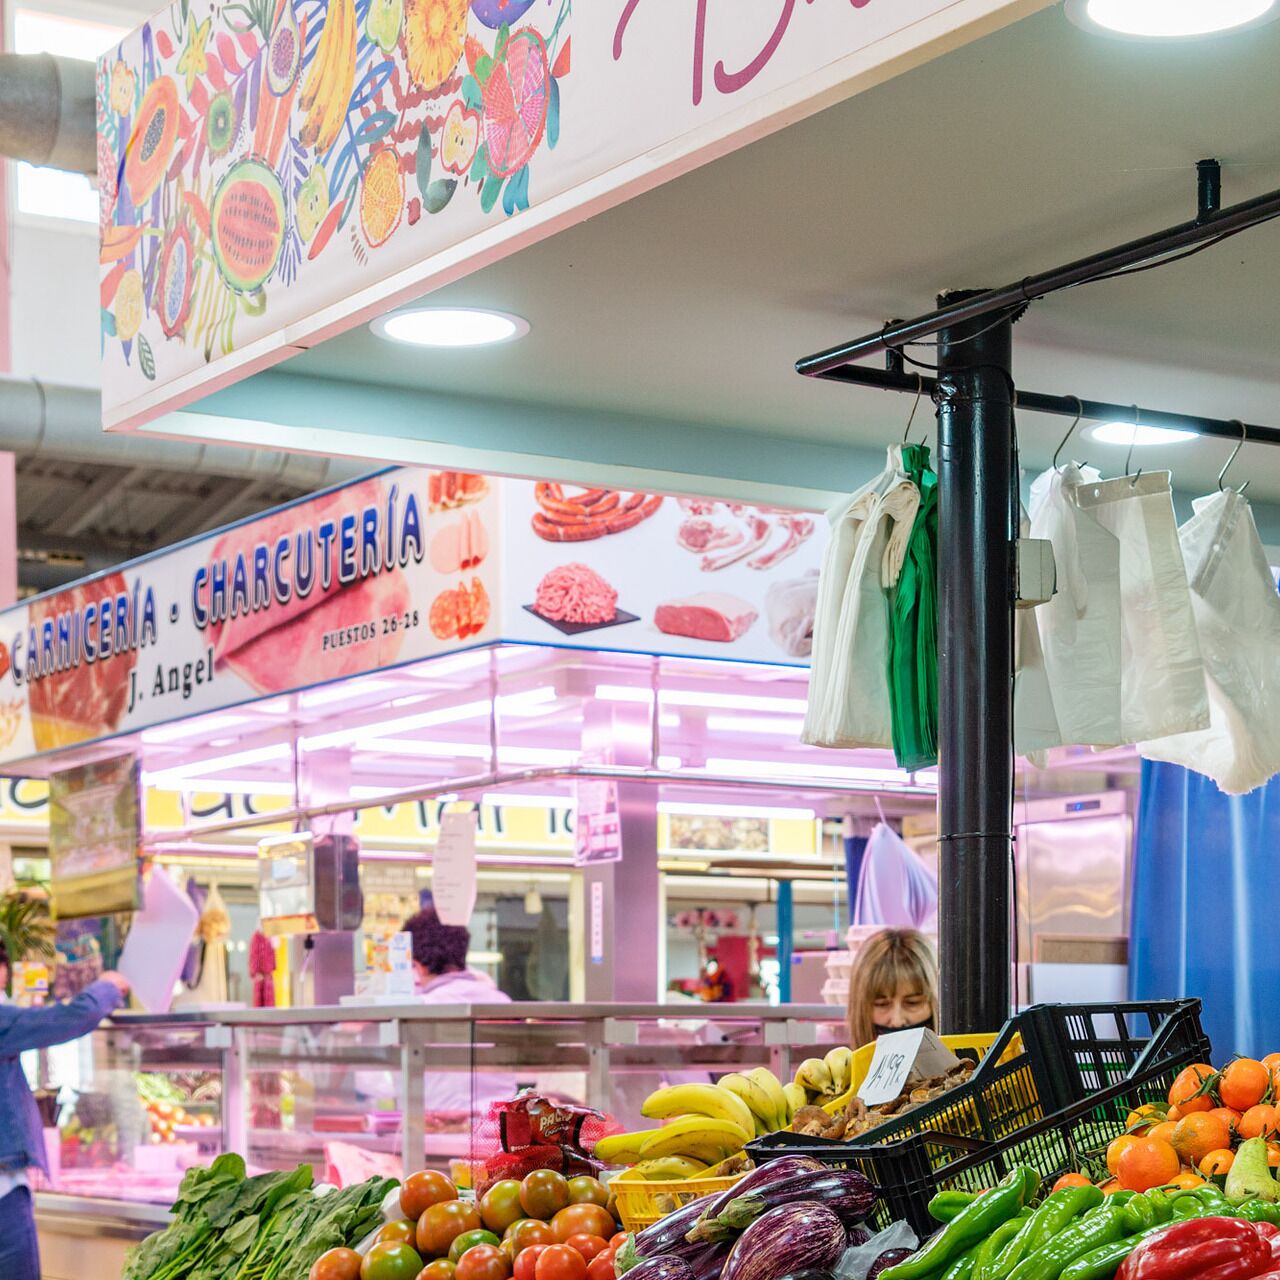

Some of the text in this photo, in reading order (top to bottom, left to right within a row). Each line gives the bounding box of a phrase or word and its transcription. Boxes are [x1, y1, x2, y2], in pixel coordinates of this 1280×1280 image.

[9, 483, 426, 687] CARNICERÍA CHARCUTERÍA
[322, 609, 420, 651] PUESTOS 26-28
[126, 647, 215, 713] J. Angel
